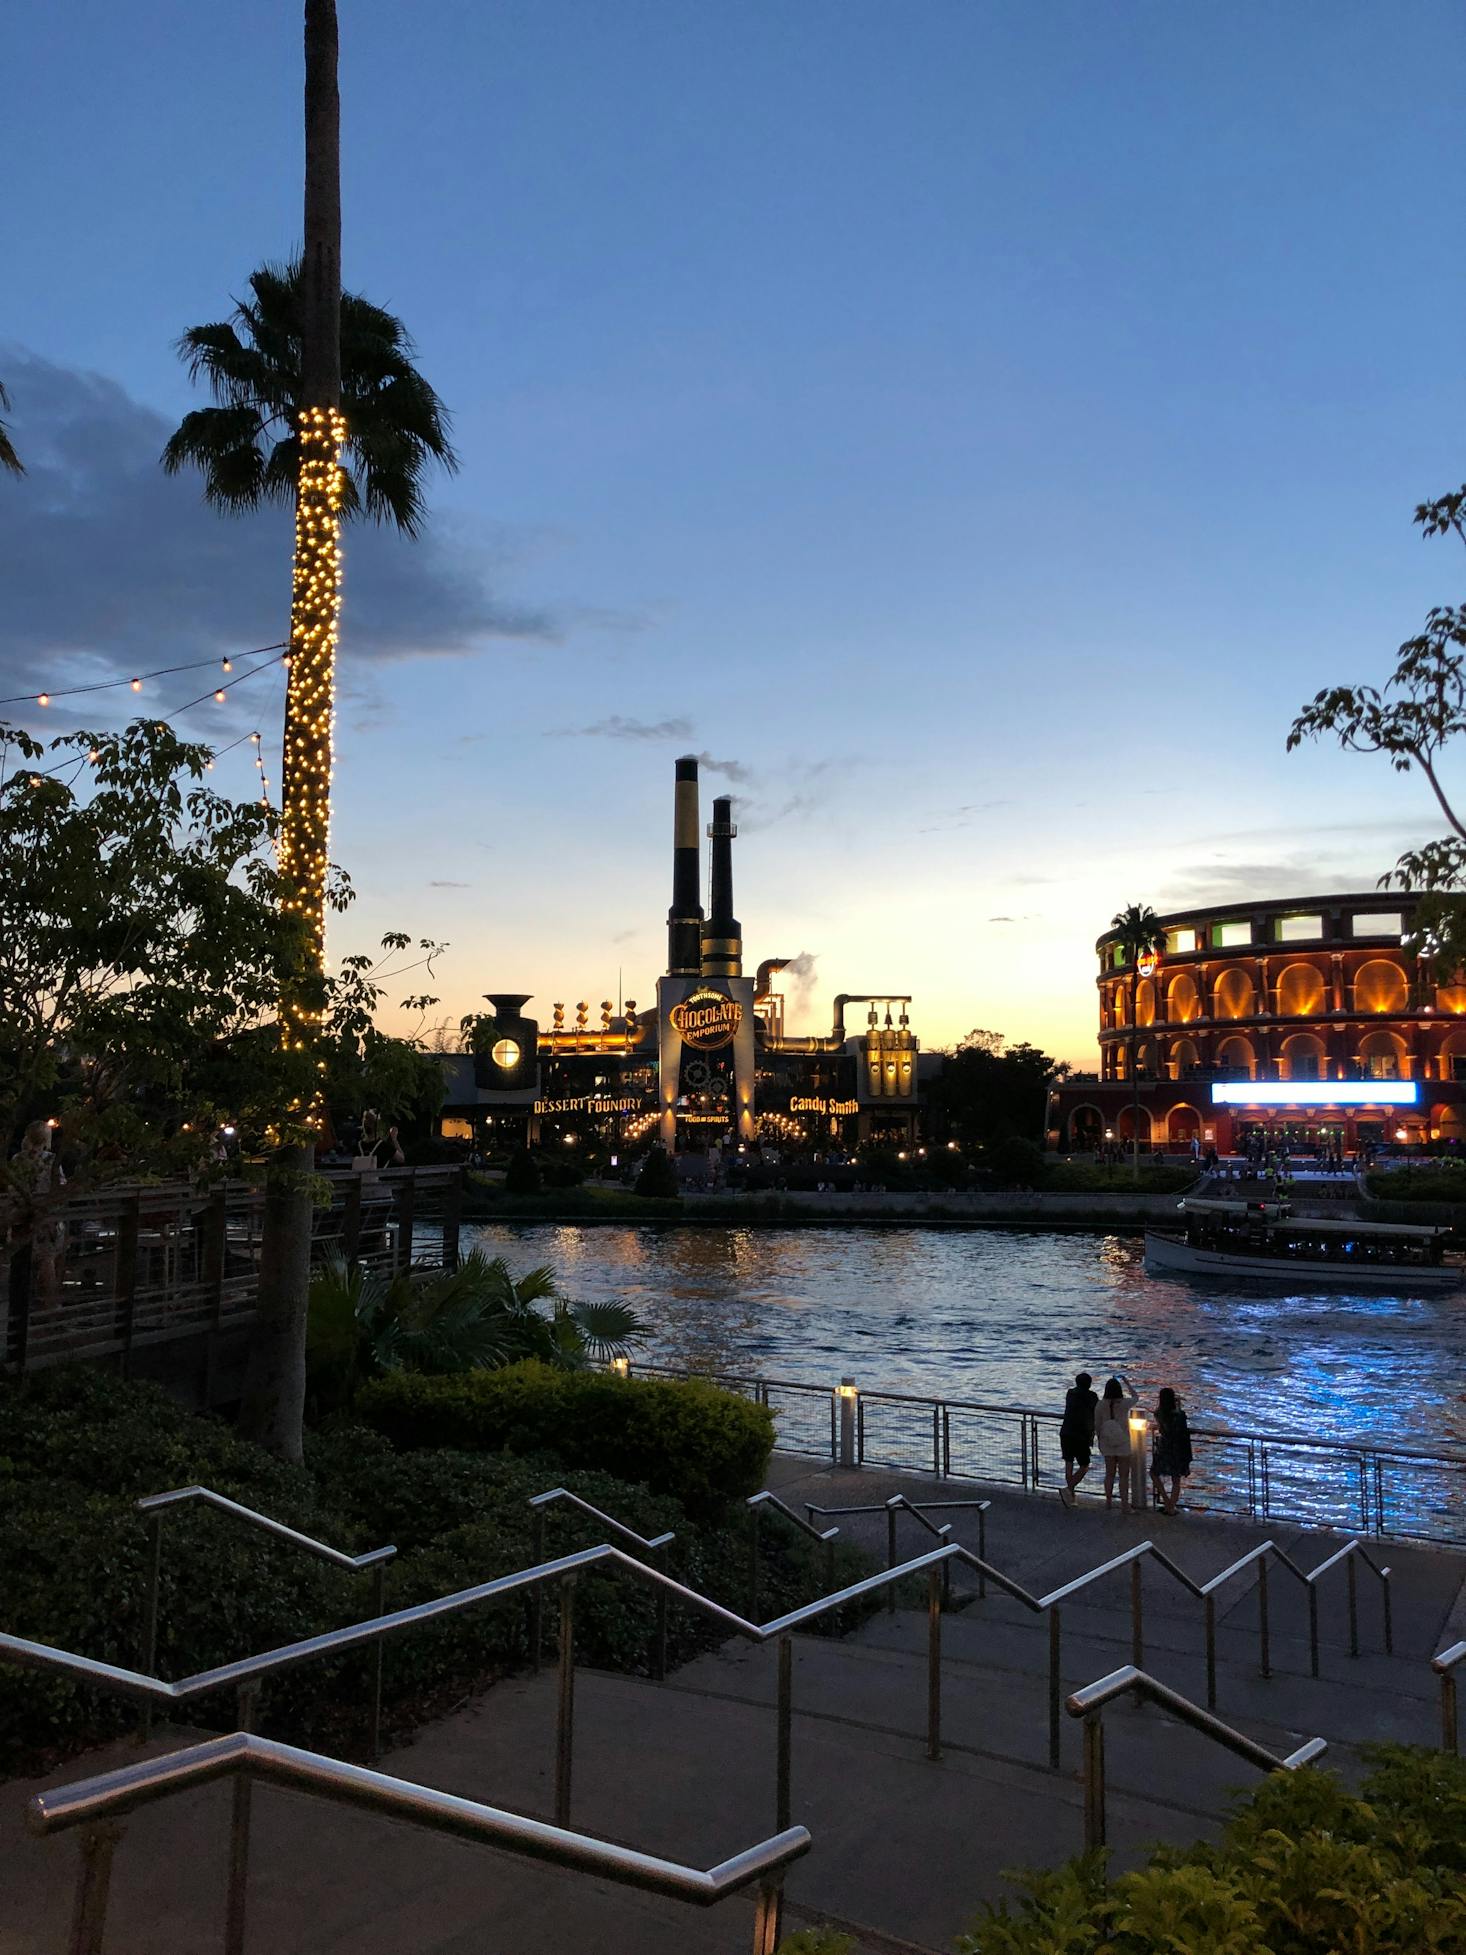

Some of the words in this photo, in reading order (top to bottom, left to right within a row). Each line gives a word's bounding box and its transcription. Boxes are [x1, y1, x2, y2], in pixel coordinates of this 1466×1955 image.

[688, 992, 723, 1003] TOOTHSOME
[669, 1003, 743, 1031] CHOCOLATE
[687, 1023, 730, 1040] EMPORIUM
[534, 1097, 588, 1114] DESSERT
[588, 1098, 642, 1114] FOUNDRY
[790, 1096, 826, 1115] Candy
[829, 1098, 859, 1114] Smith
